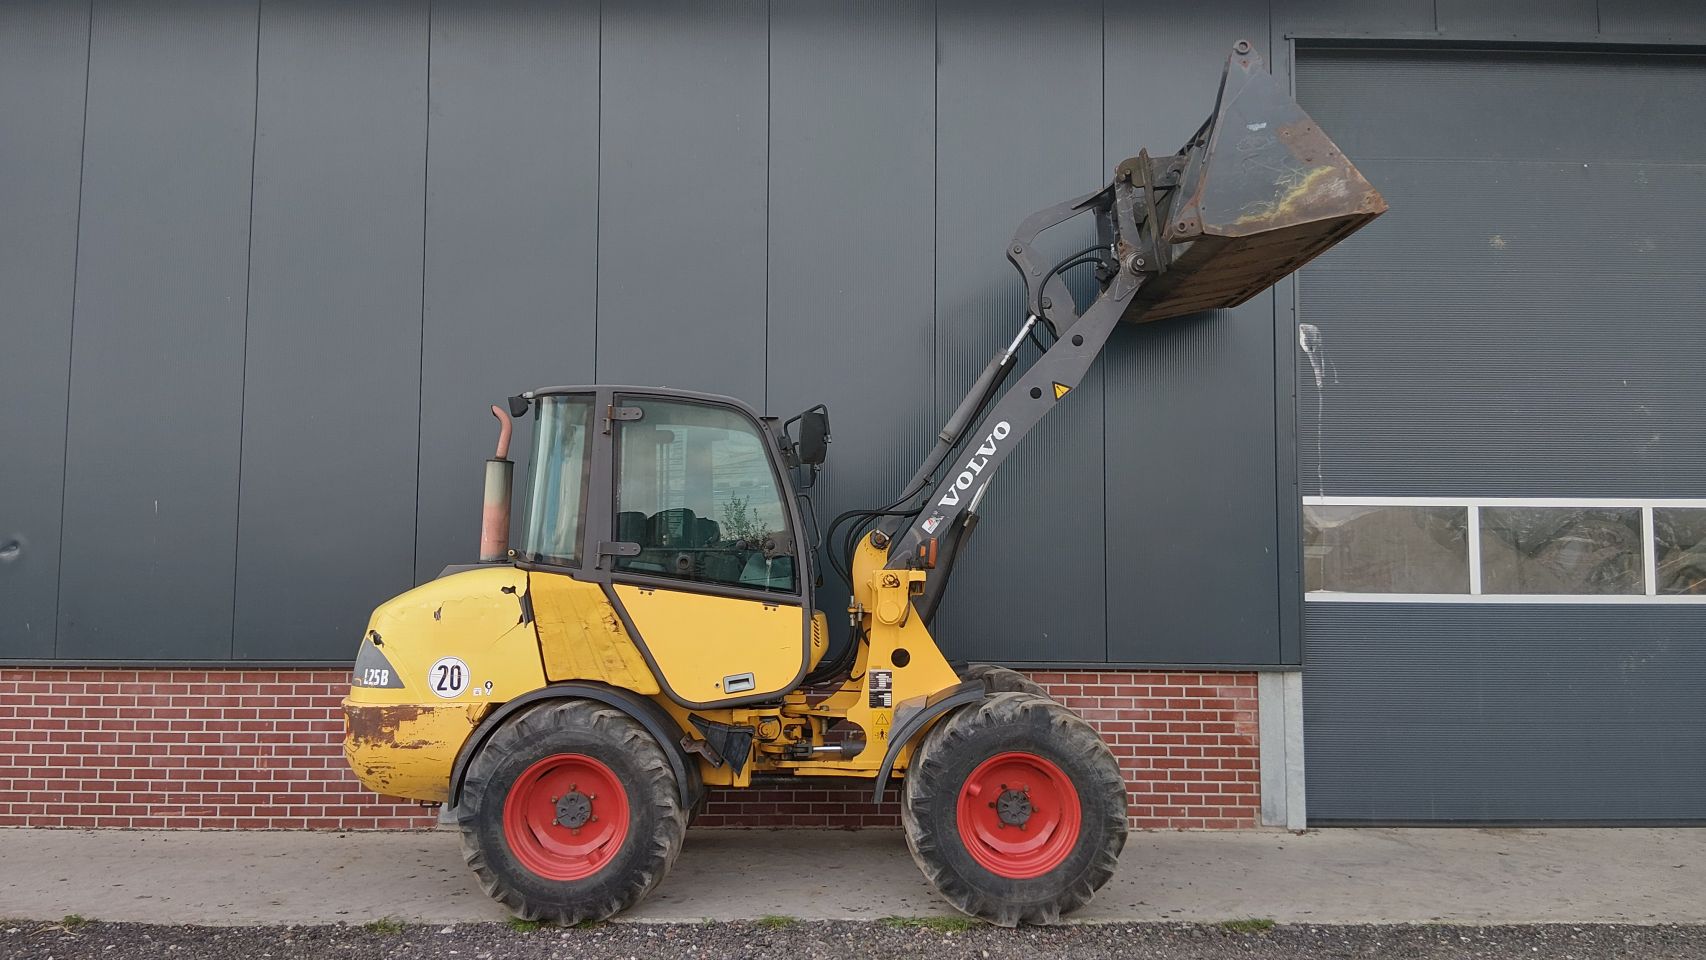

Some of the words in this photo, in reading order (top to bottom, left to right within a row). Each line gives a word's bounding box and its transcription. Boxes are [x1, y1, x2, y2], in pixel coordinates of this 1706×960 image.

[937, 420, 1011, 507] VOLVO
[363, 668, 390, 686] L25B
[437, 664, 462, 691] 20
